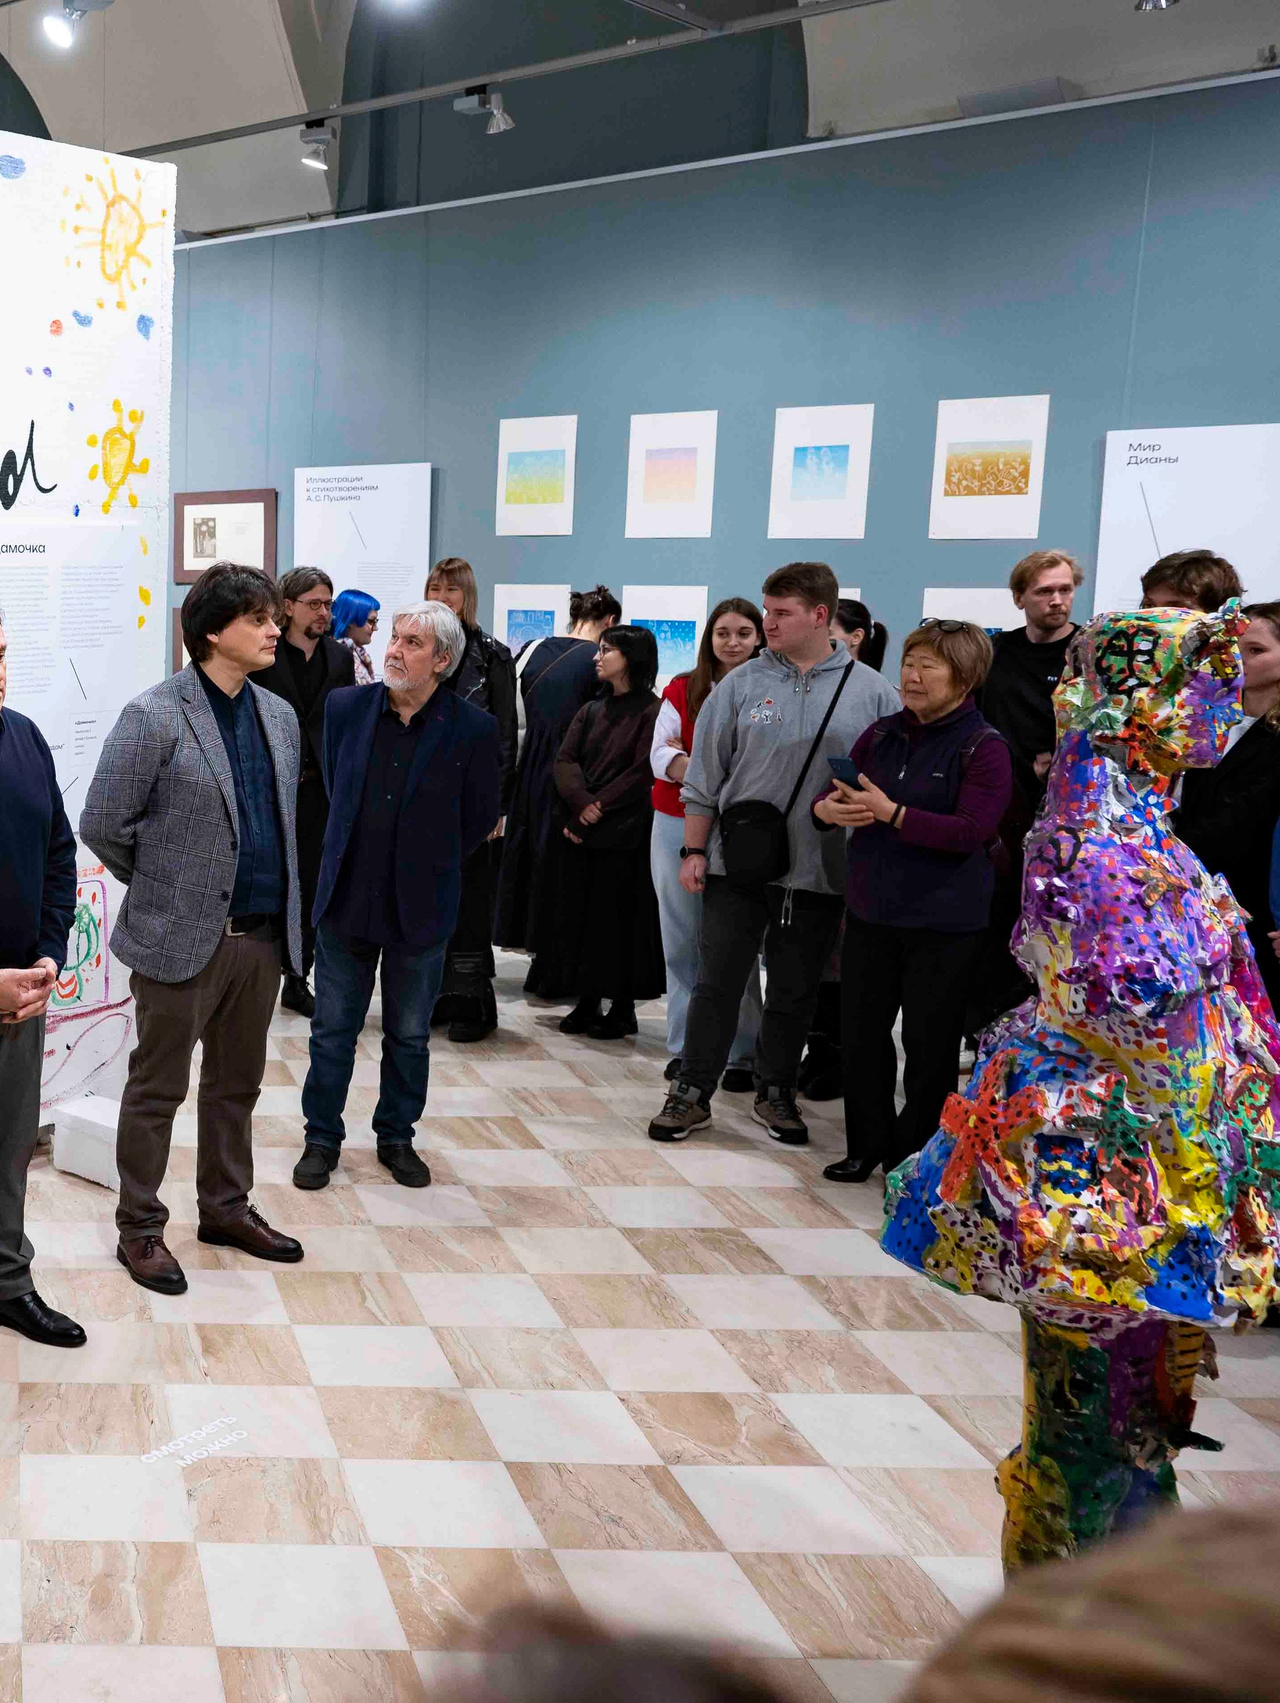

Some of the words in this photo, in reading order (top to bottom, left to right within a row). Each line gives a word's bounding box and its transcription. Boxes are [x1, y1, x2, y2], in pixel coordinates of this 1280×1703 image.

[1127, 442, 1162, 453] Мир
[1126, 455, 1179, 466] Дианы
[306, 476, 364, 484] Иллюстрации
[312, 485, 379, 493] стихотворениям
[323, 494, 361, 503] Пушкина
